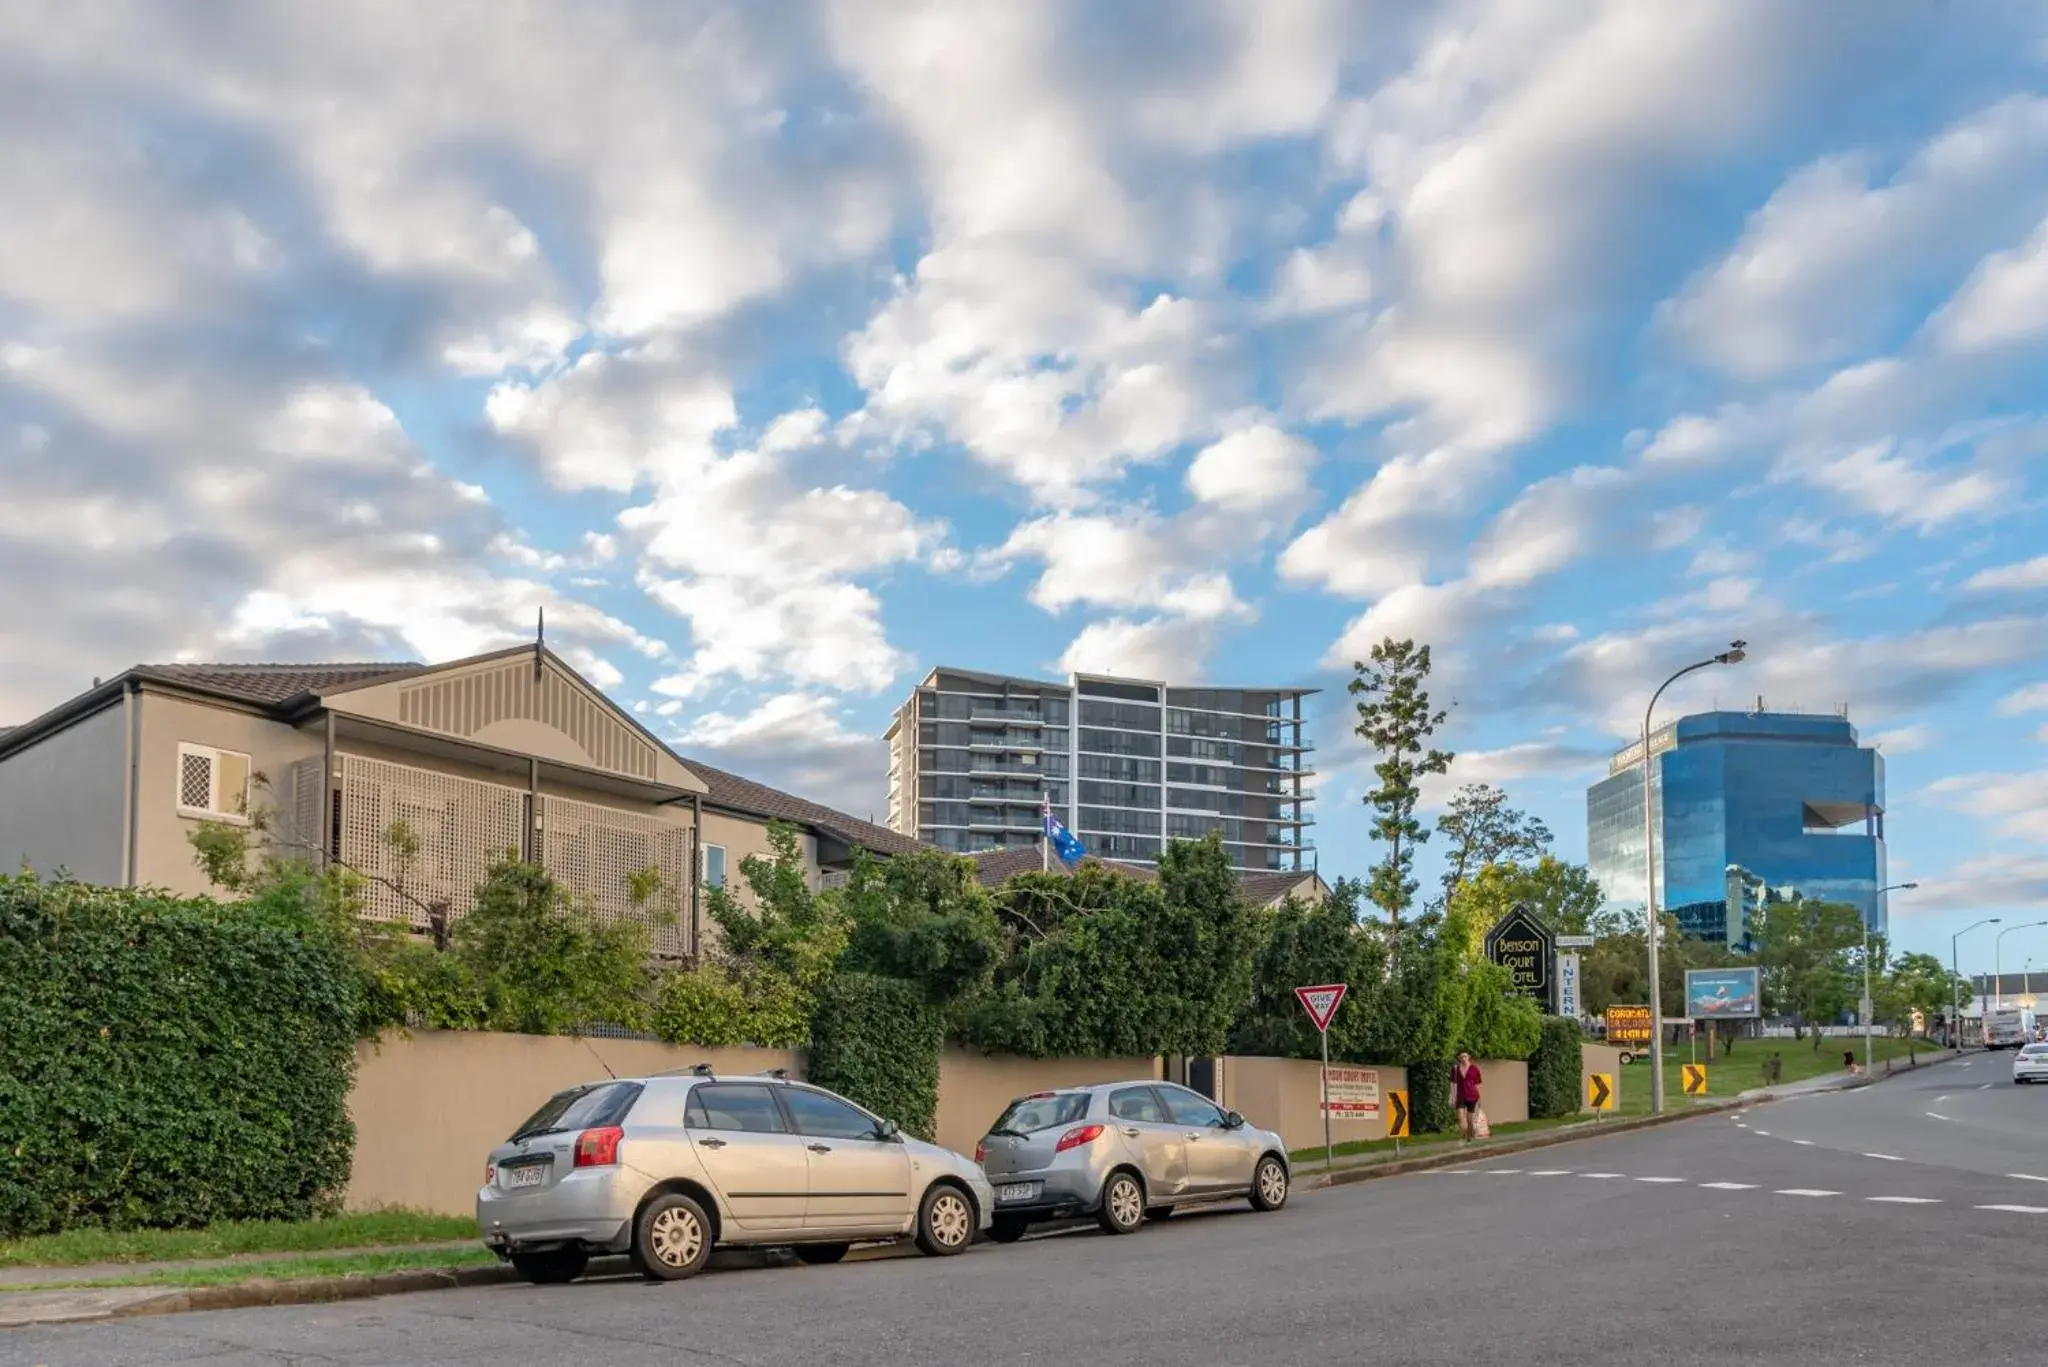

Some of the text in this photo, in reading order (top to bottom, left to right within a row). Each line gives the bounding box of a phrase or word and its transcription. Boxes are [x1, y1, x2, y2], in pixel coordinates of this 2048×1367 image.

[1503, 955, 1535, 968] COURT
[1510, 971, 1537, 983] OTEL
[1311, 993, 1333, 1002] GIVE
